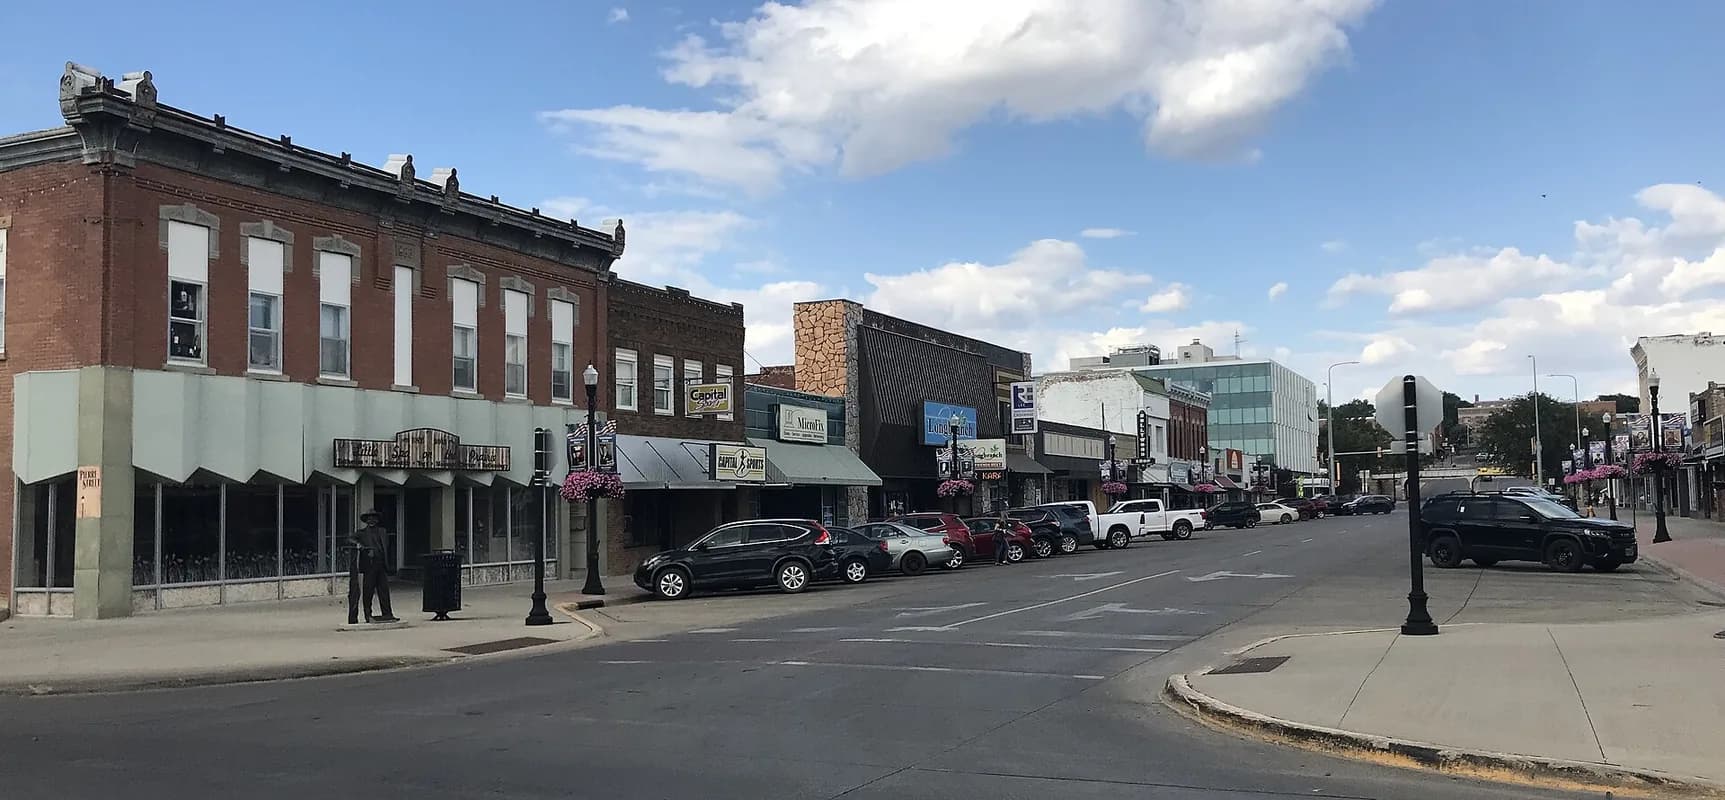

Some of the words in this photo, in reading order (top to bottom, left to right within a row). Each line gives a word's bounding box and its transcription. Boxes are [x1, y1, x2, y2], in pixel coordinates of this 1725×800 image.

[690, 388, 727, 401] Capital
[797, 417, 824, 431] MicroFix
[928, 418, 973, 437] Longbnch
[718, 455, 738, 469] CAPITAL
[746, 457, 764, 470] SPORTS
[80, 471, 96, 480] PIERRE
[83, 479, 100, 489] STREET
